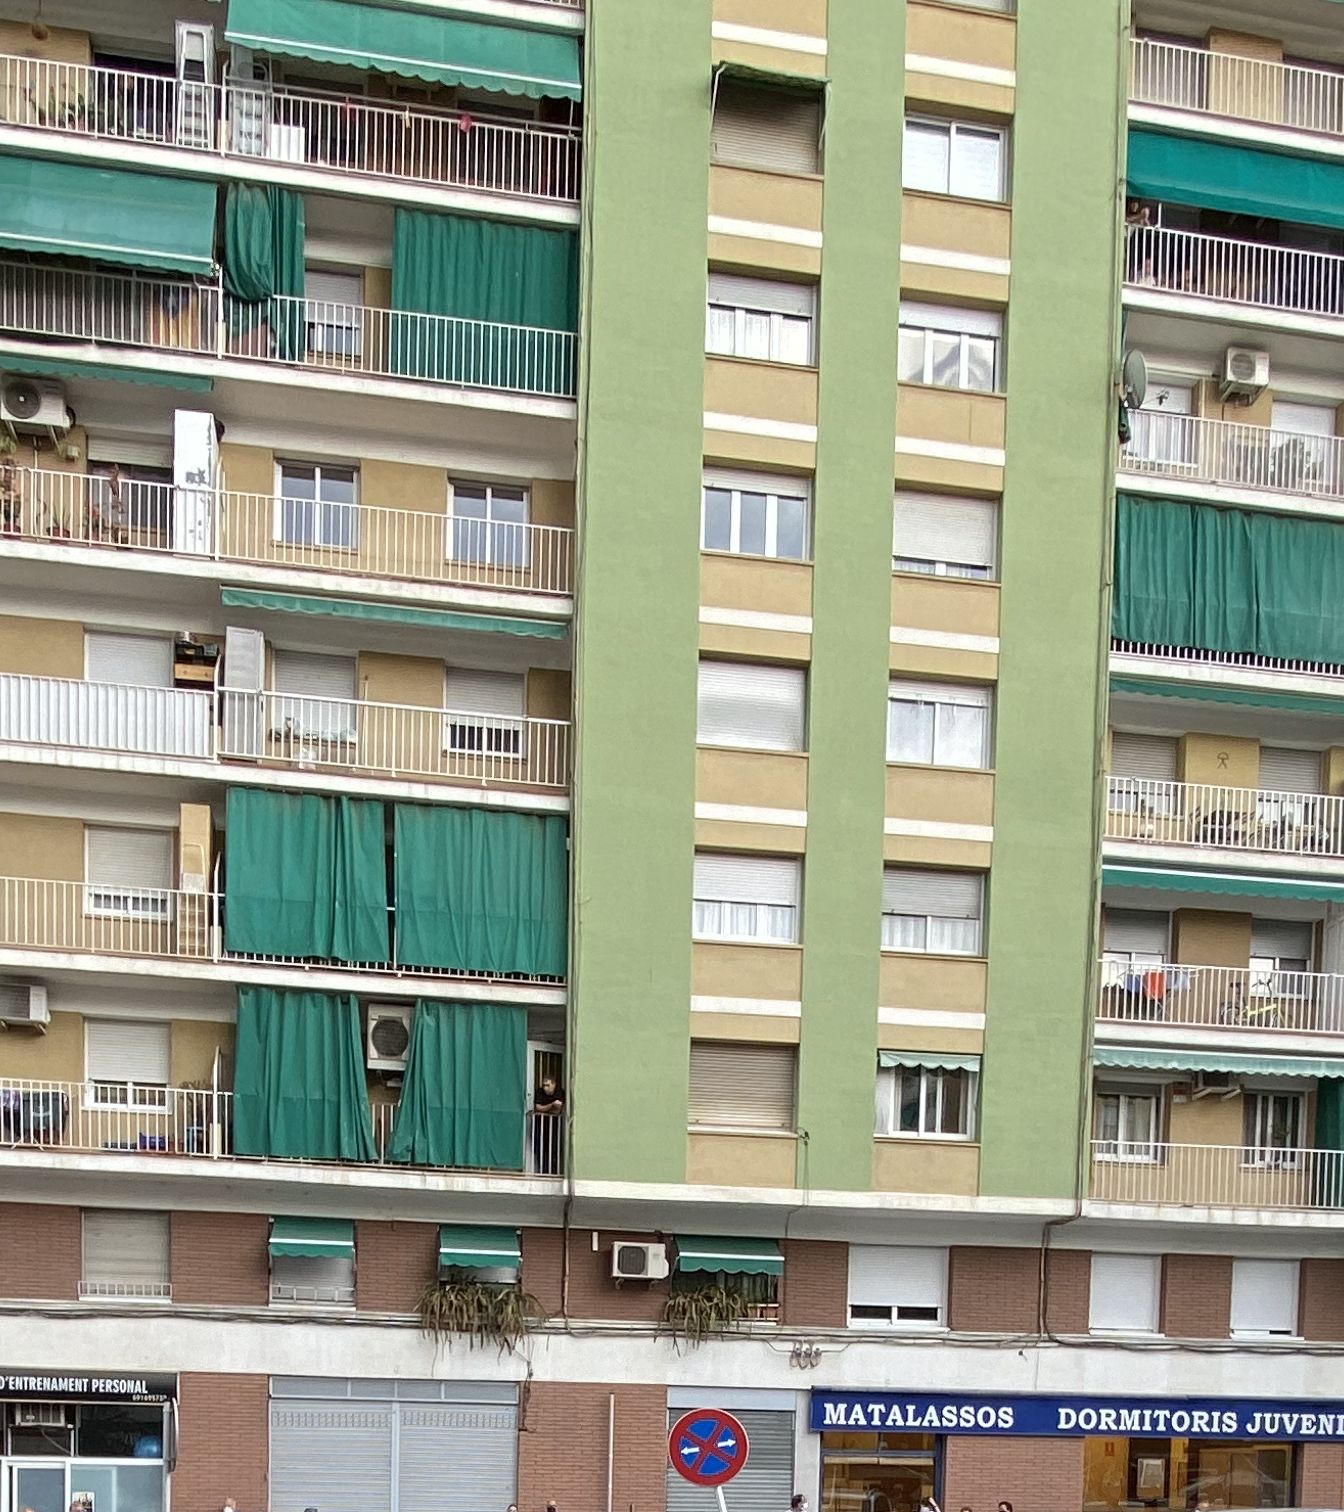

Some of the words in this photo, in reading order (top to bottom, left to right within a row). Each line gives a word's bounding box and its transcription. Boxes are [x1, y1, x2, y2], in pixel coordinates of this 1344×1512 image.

[91, 1378, 149, 1394] PERSONAL
[823, 1403, 1014, 1428] MATALASSOS
[1057, 1407, 1238, 1434] DORMITORIS
